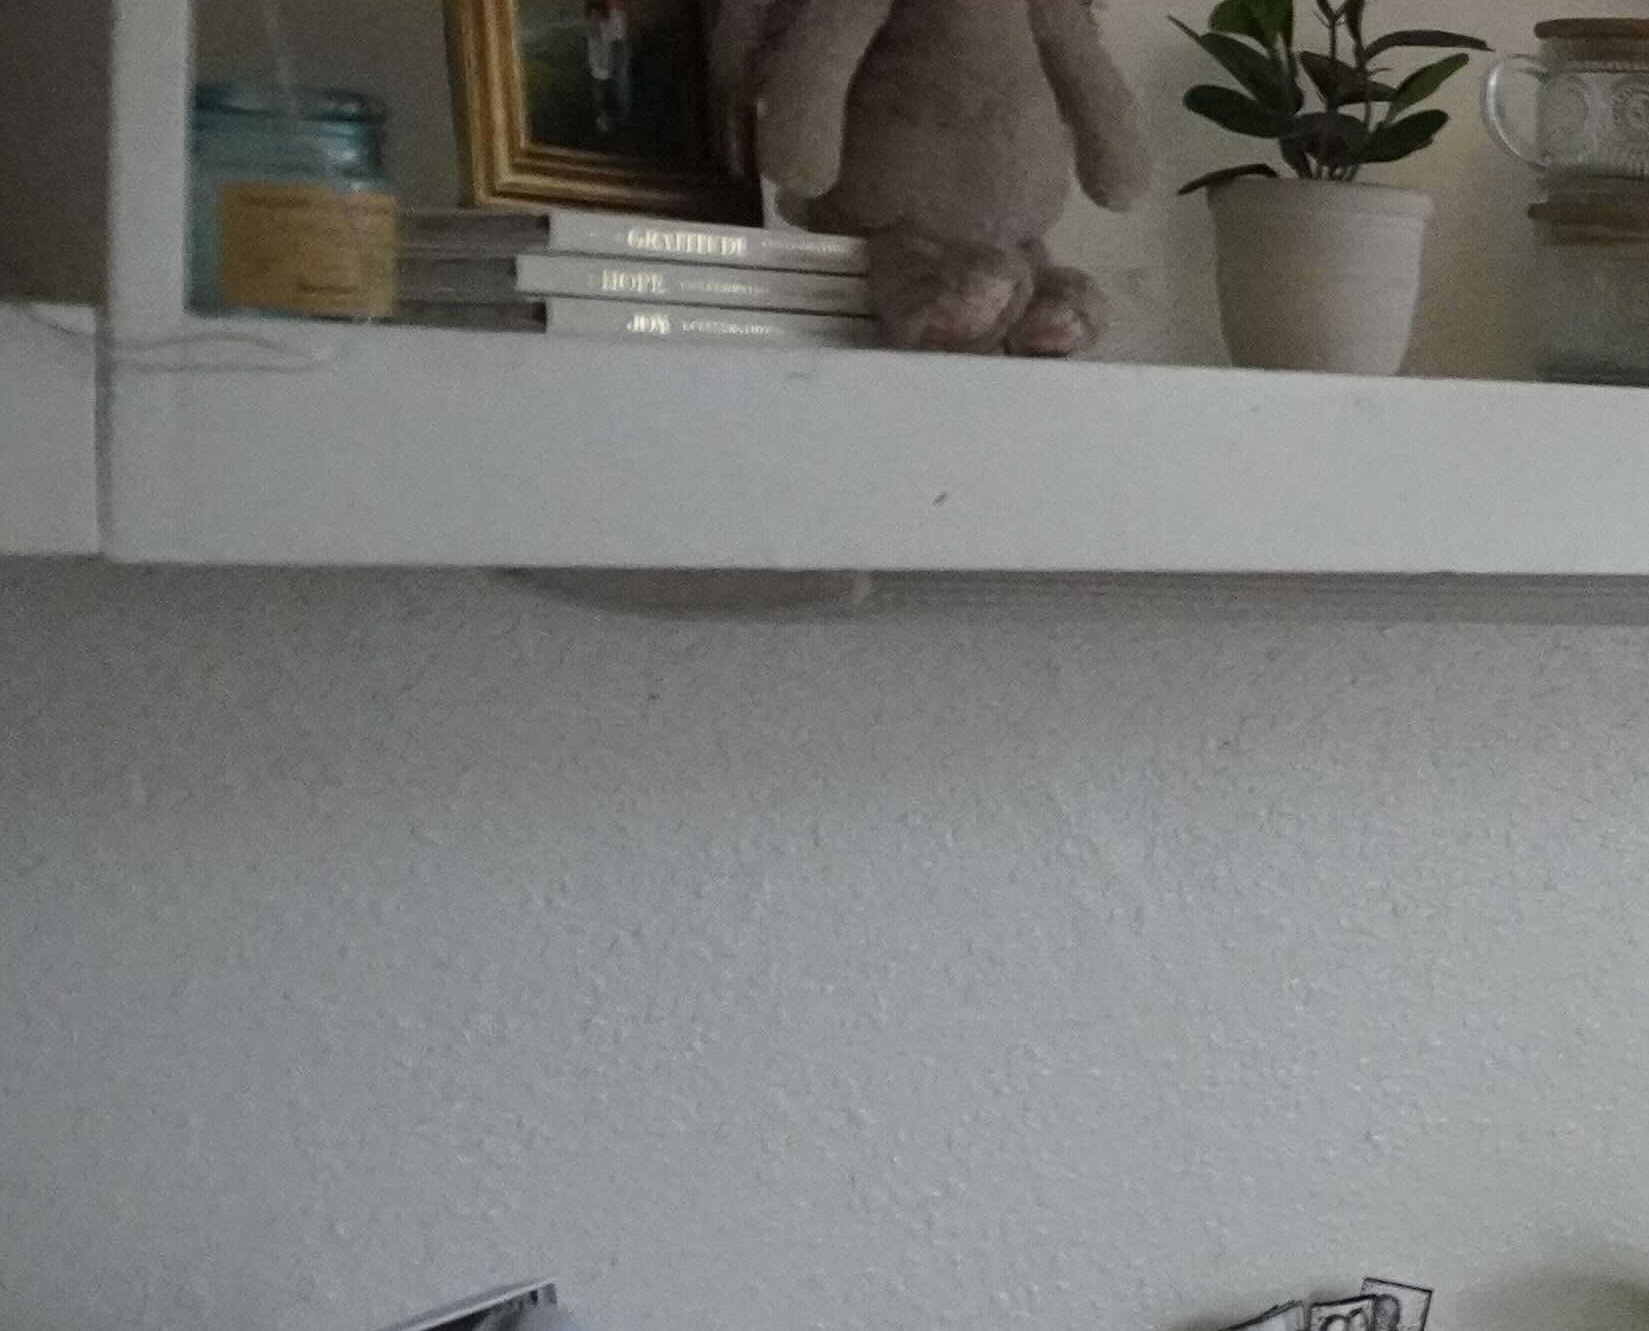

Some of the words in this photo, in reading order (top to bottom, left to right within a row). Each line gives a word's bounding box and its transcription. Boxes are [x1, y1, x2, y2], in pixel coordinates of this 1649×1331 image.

[628, 229, 748, 256] GRATITUDE
[602, 270, 667, 295] HOPE
[627, 313, 670, 335] JOY
